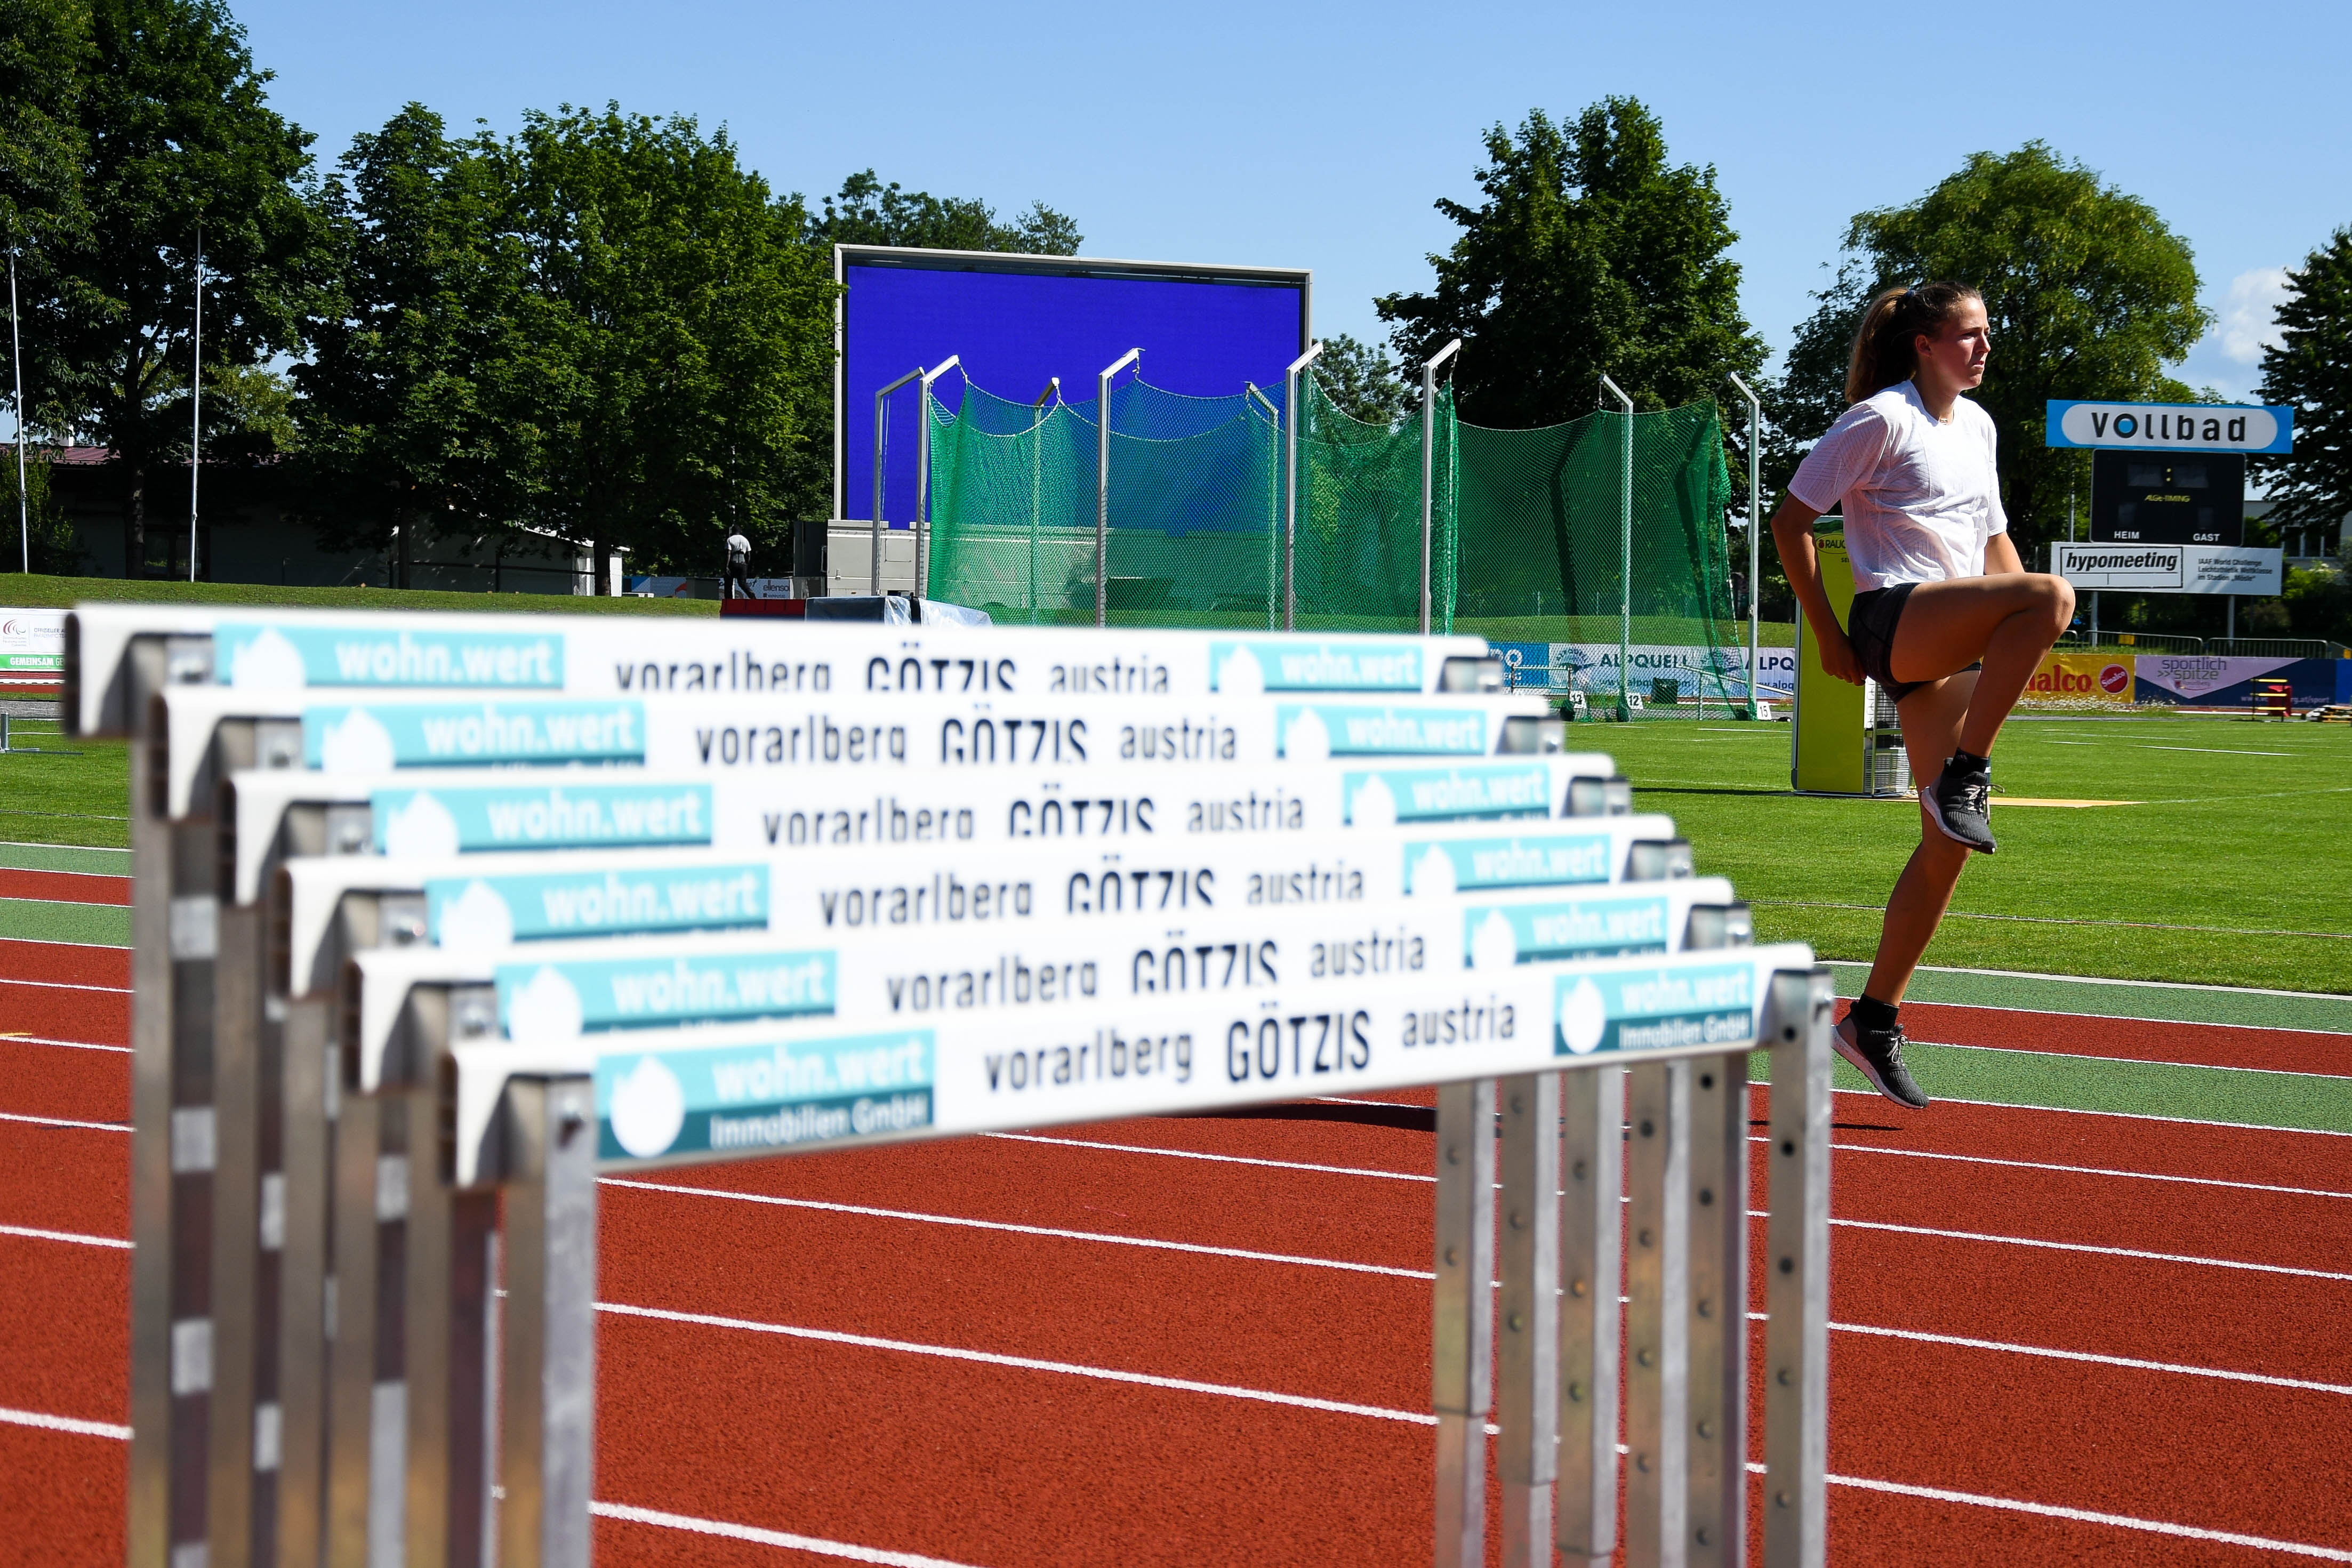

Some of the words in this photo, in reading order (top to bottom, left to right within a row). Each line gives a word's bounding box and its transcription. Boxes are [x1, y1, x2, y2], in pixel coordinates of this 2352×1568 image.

[2114, 531, 2140, 540] HEIM
[2193, 533, 2220, 542] GAST
[2066, 552, 2178, 572] hypomeeting
[10, 657, 54, 666] GEMEINSAM
[335, 633, 553, 683] wohn.wert
[1050, 654, 1169, 693] austria
[1282, 645, 1417, 685] wohn.wert
[2162, 657, 2227, 672] sportlich
[1628, 695, 1639, 706] 12
[1760, 705, 1768, 717] 15
[423, 704, 635, 754] wohn.wert
[1121, 717, 1237, 760] austria
[1346, 710, 1480, 749] wohn.wert
[1188, 787, 1303, 832] austria
[1412, 769, 1544, 810] wohn.wert
[487, 787, 703, 839] wohn.wert
[1472, 841, 1606, 879] wohn.wert
[542, 869, 759, 926] wohn.wert
[1247, 861, 1363, 905] austria
[1532, 903, 1663, 945] wohn.wert
[1311, 928, 1424, 979] austria
[611, 956, 826, 1013] wohn.wert
[1620, 969, 1749, 1012] wohn.wert
[1227, 1002, 1370, 1083] GÖTZIS
[1403, 994, 1515, 1049] austria
[1704, 1012, 1751, 1043] GmbH
[712, 1036, 925, 1101] wohn.wert
[985, 1028, 1192, 1092] vorarlberg
[852, 1092, 928, 1135] GmbH
